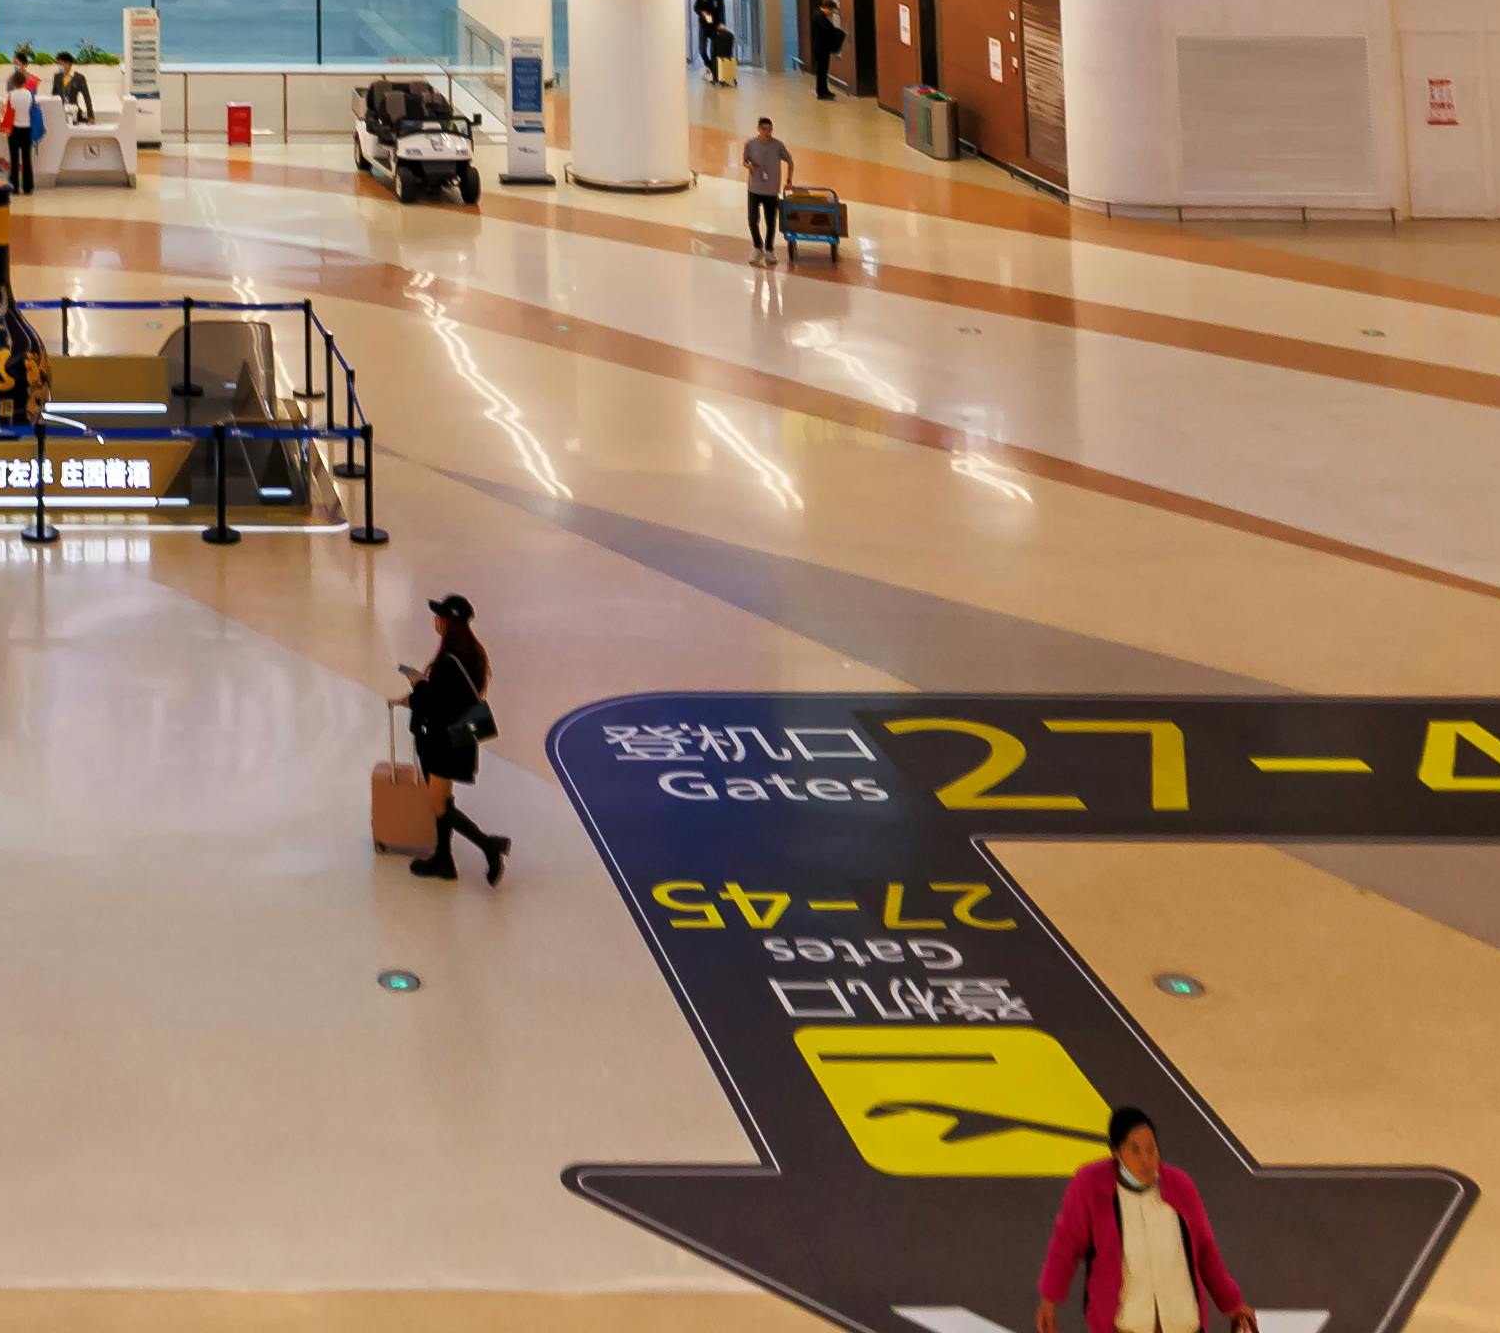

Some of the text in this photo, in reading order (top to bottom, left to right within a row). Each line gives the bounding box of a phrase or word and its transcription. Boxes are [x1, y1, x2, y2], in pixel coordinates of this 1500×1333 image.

[60, 458, 151, 490] 庄园酱酒
[602, 723, 878, 764] 登机口
[655, 769, 891, 805] Gates
[652, 878, 1019, 932] 27-45
[763, 934, 967, 972] Gates
[769, 974, 1034, 1023] 登机口
